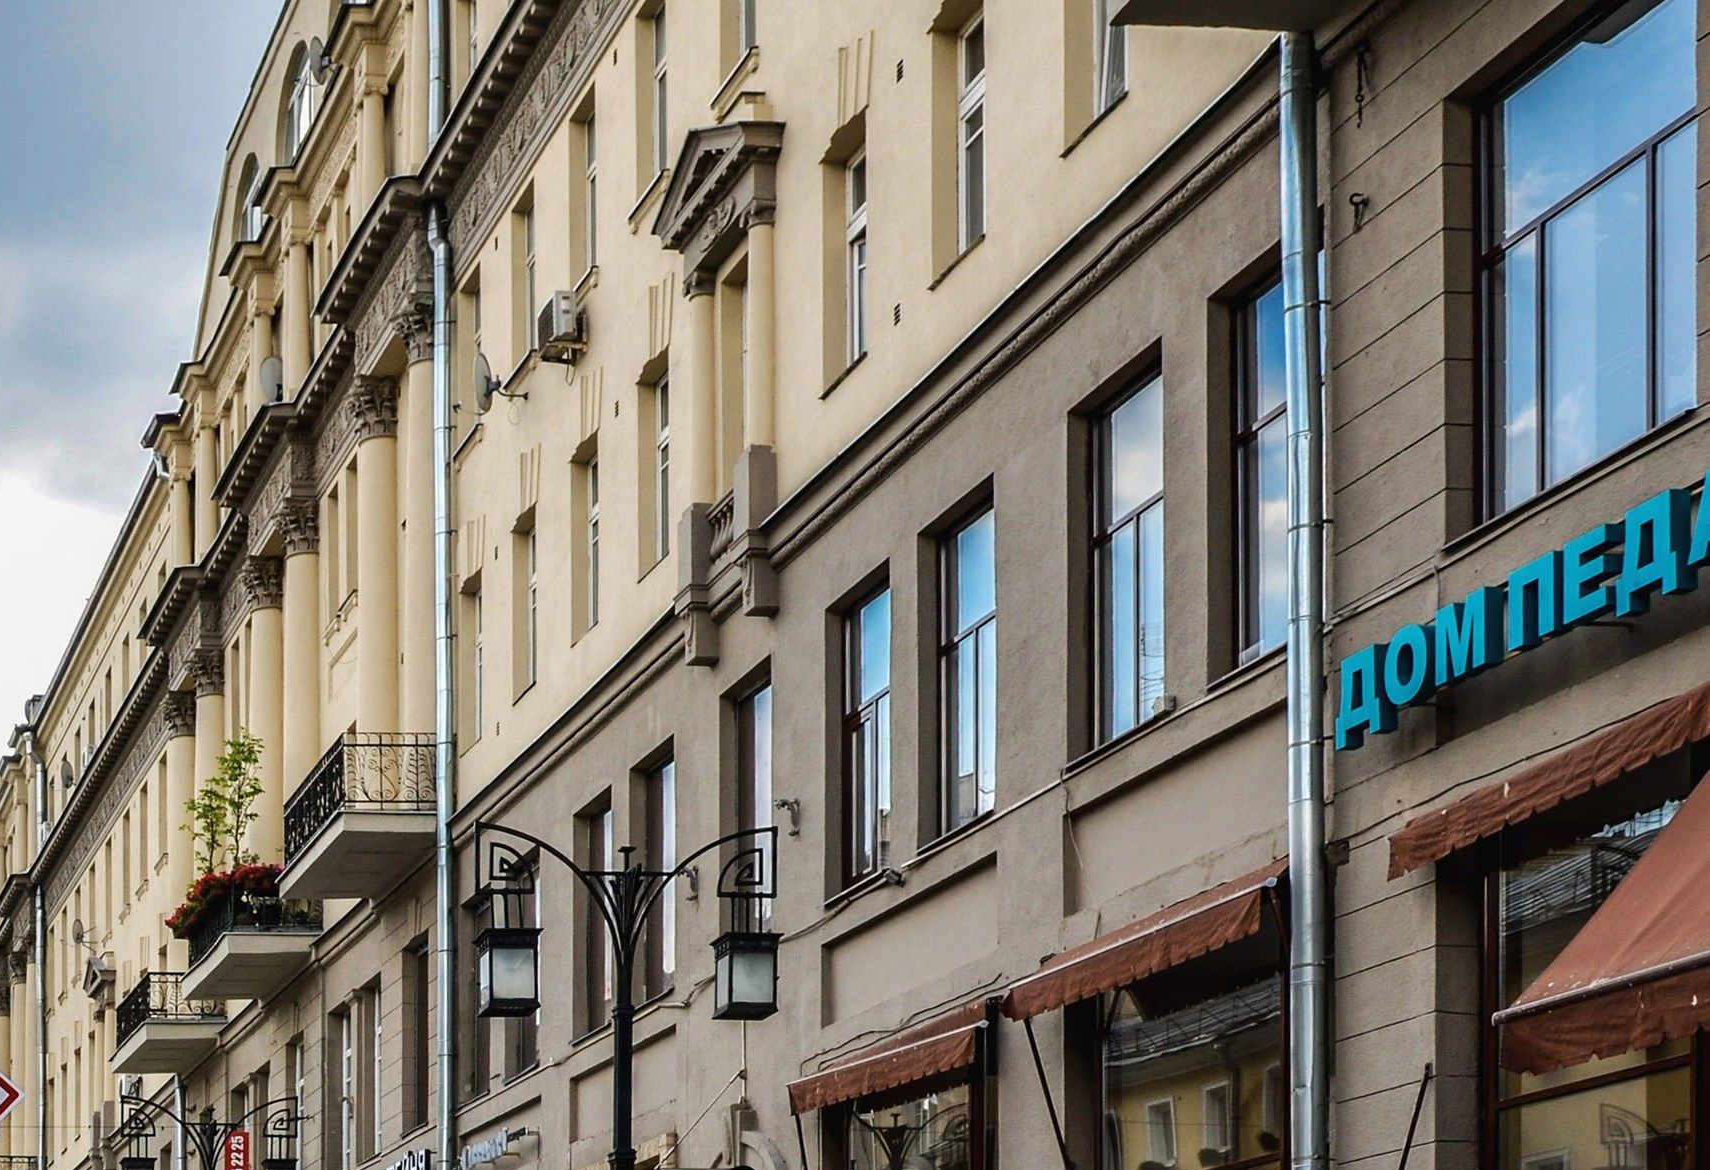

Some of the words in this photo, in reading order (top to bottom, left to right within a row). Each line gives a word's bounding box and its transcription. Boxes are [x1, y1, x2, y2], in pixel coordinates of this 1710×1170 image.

[1335, 586, 1496, 751] ДОМ
[231, 1135, 244, 1151] 25
[231, 1151, 244, 1167] 22
